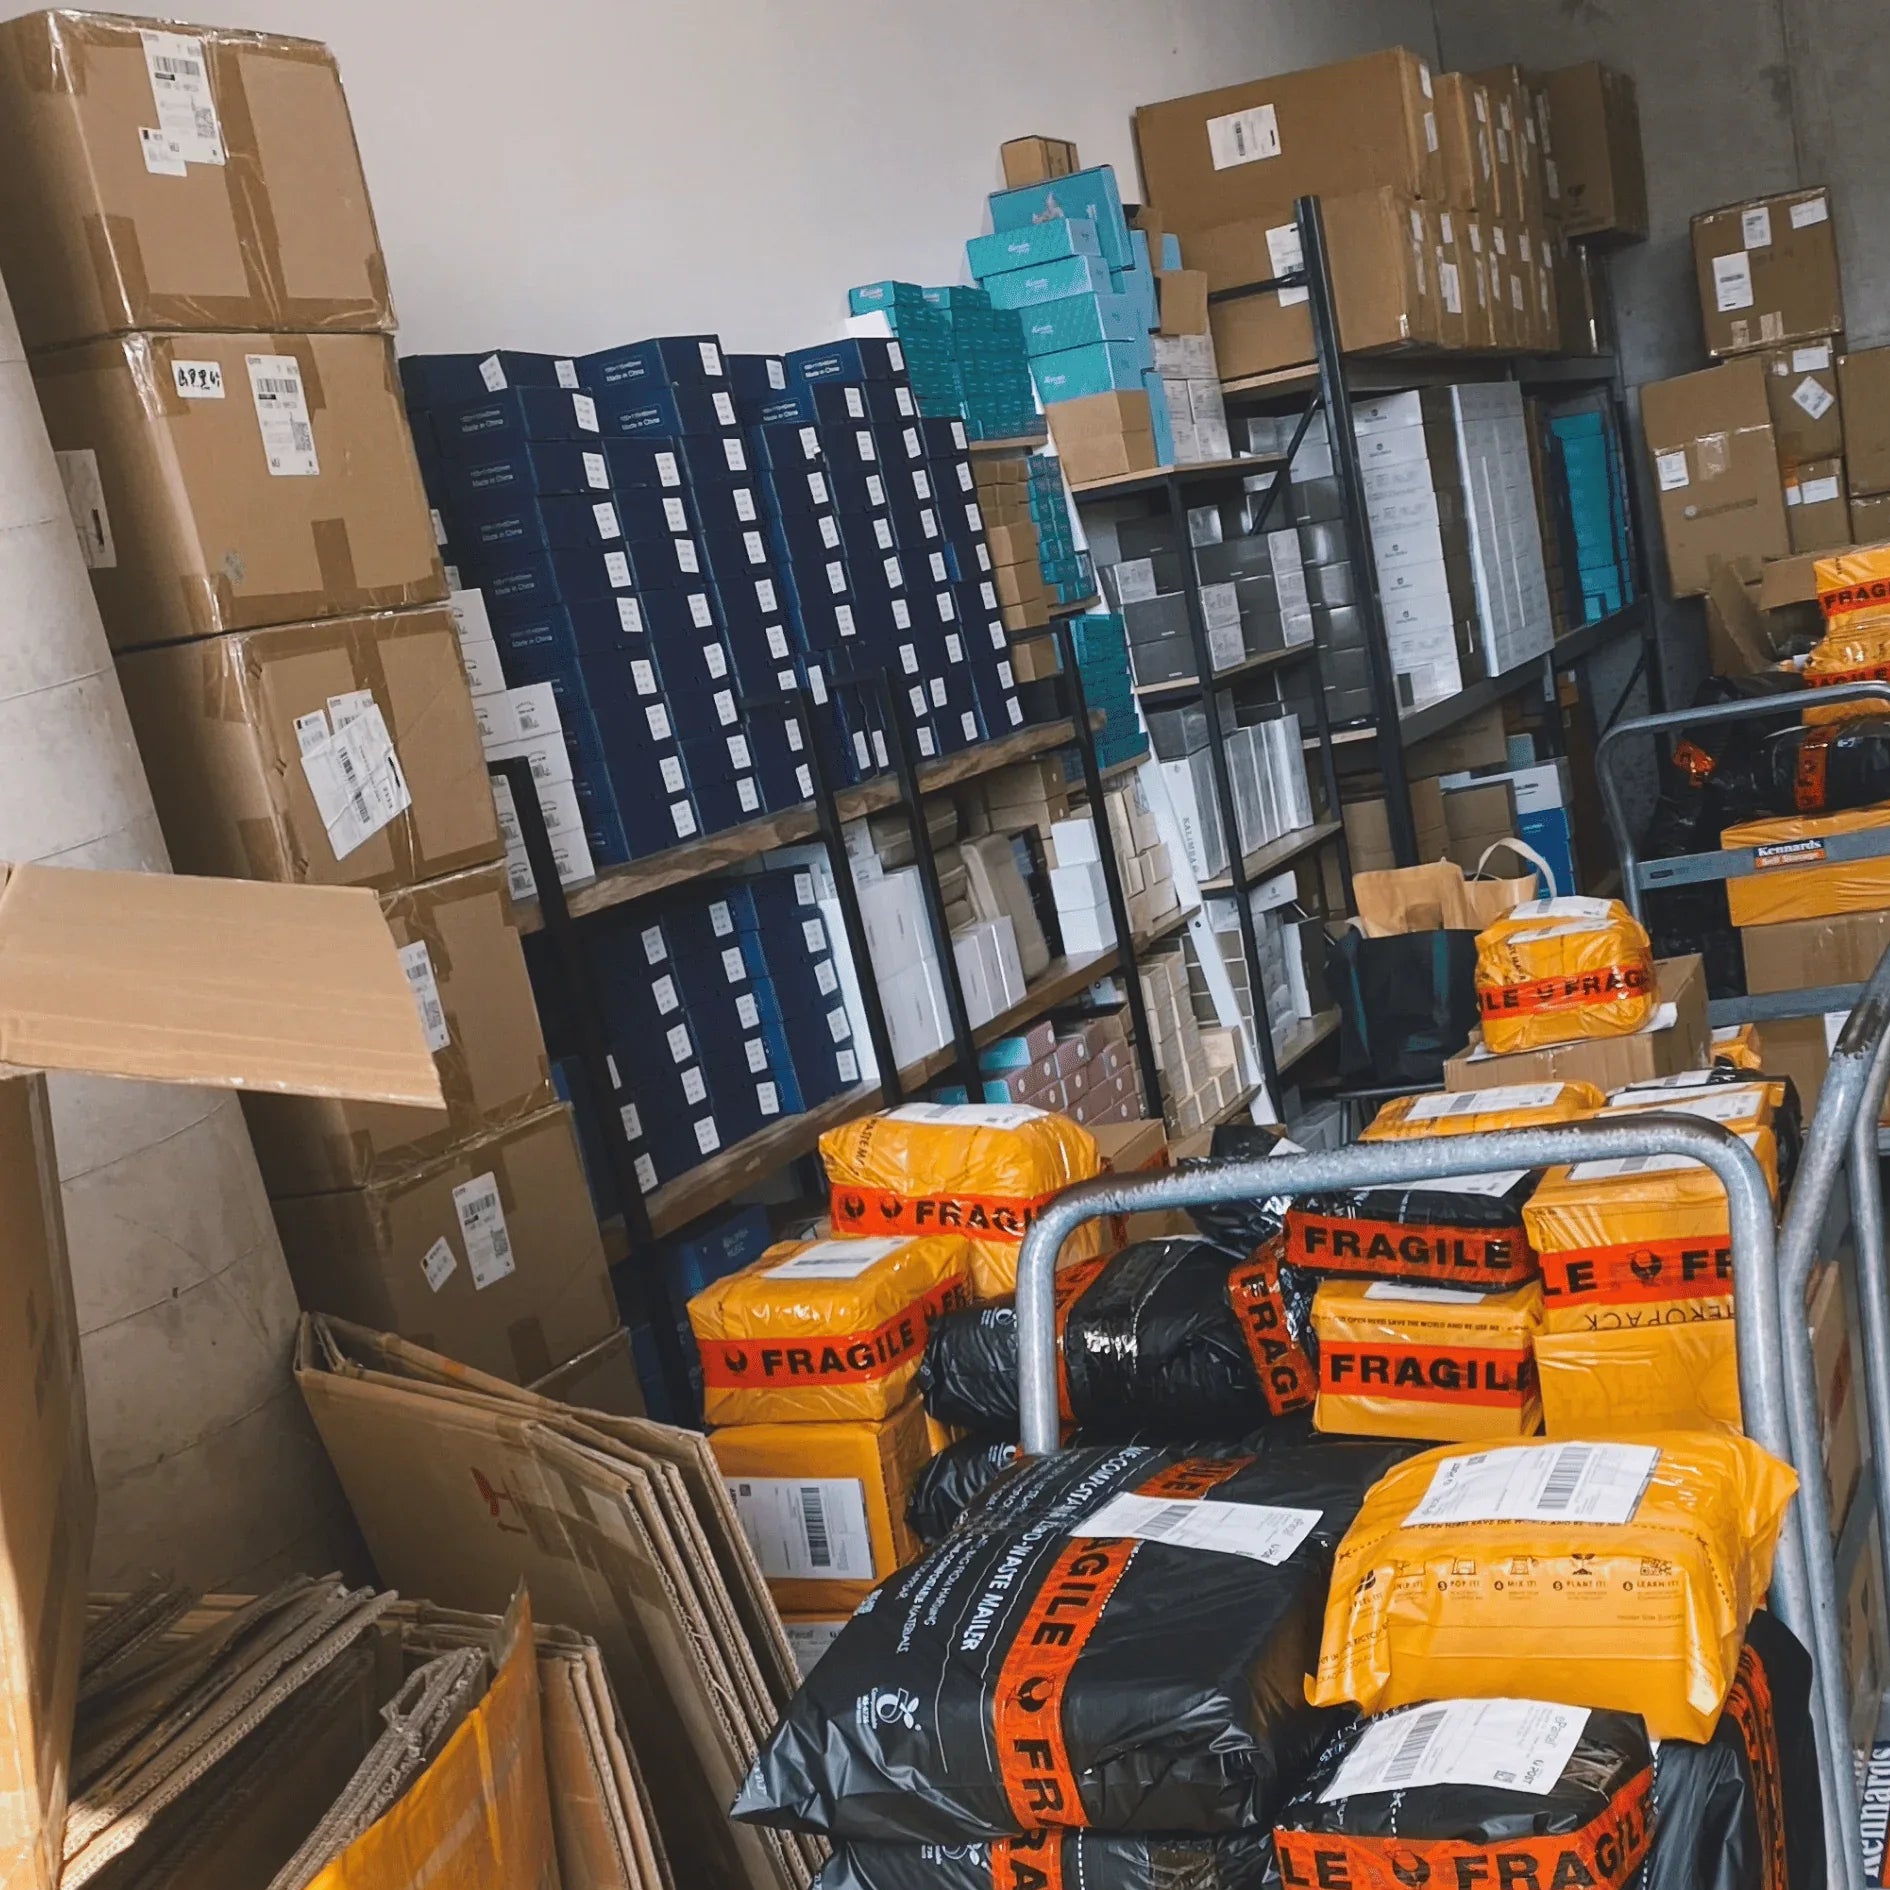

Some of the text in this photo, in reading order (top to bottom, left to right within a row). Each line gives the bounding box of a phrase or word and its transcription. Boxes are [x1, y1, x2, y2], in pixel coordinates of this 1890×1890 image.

[1758, 840, 1822, 857] Kennards
[1304, 1225, 1513, 1269] FRAGILE
[760, 1317, 915, 1378] FRAGILE
[1566, 1580, 1593, 1588] PLANT
[1637, 1580, 1665, 1588] LEARN
[961, 1591, 1004, 1651] MAILER
[1013, 1738, 1061, 1830] FR
